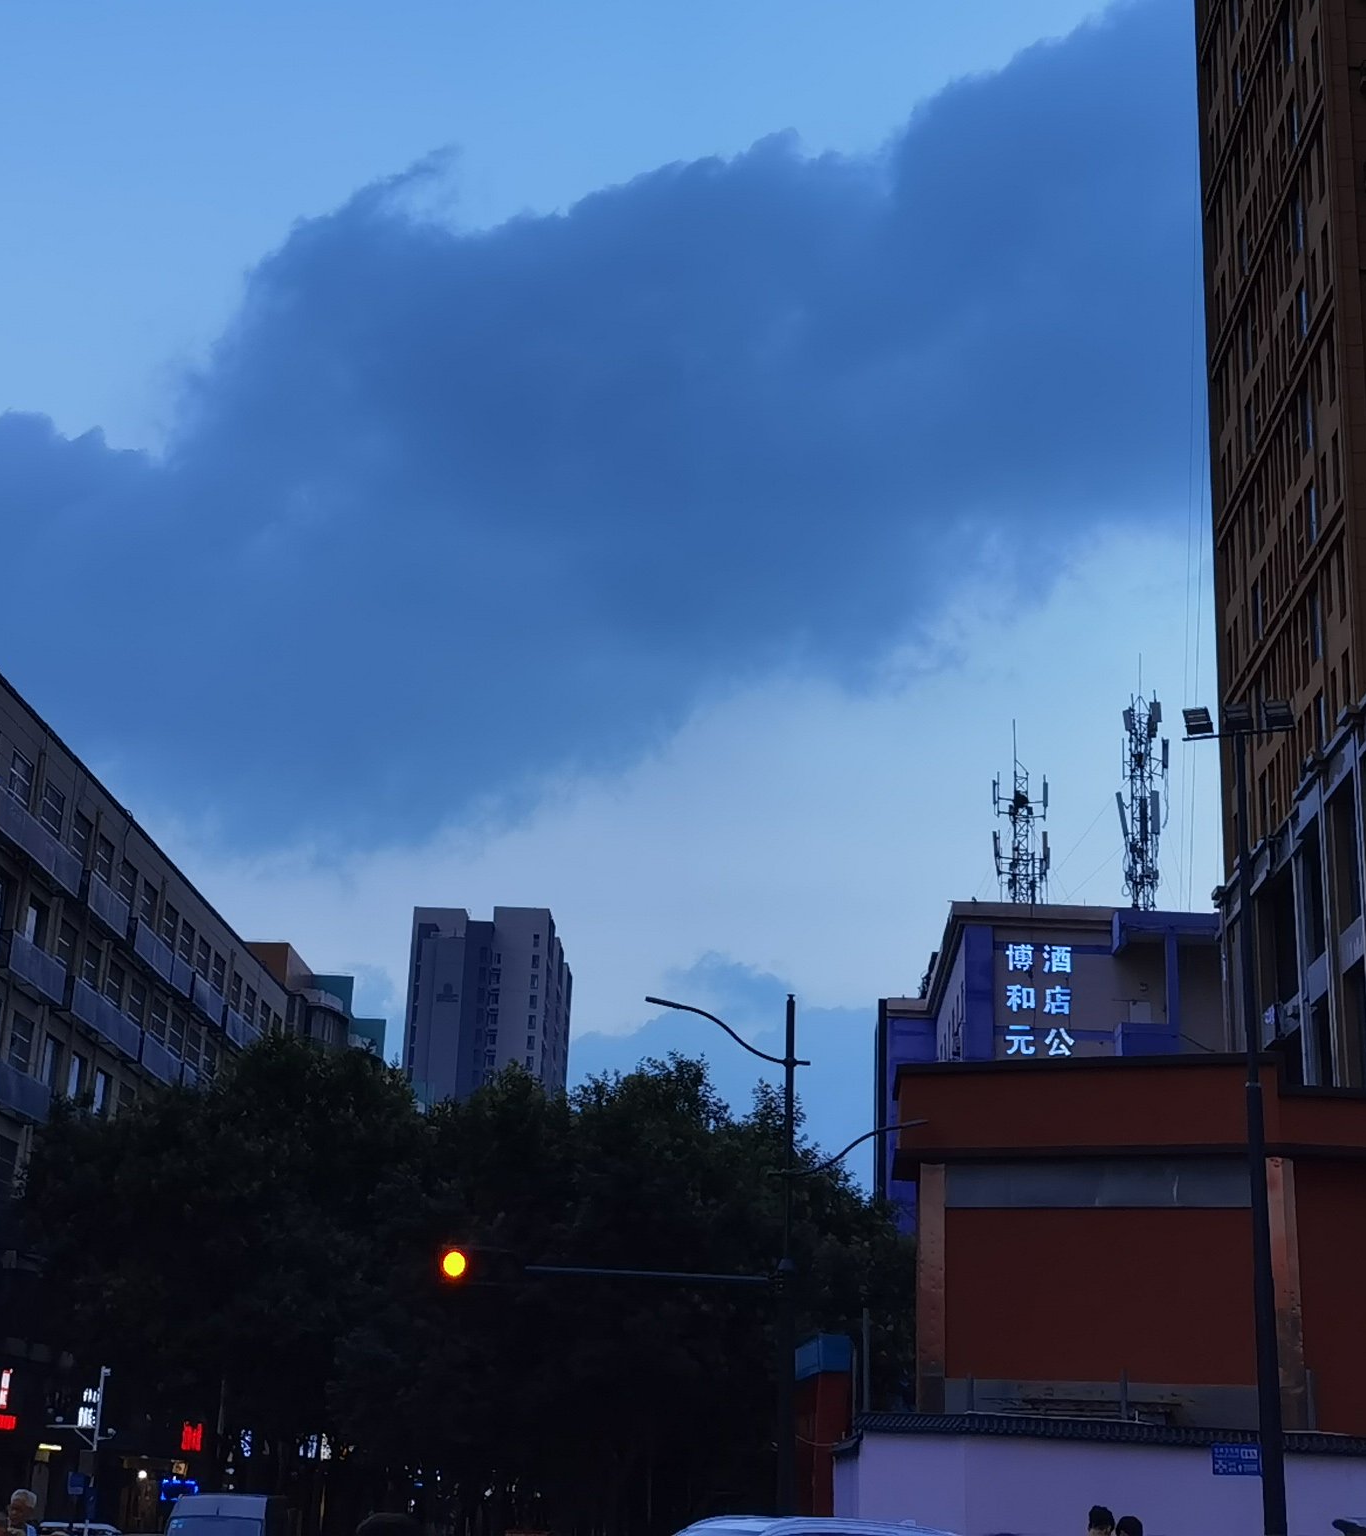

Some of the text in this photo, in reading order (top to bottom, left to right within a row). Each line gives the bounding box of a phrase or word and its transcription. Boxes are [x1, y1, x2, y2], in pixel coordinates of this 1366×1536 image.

[1006, 944, 1035, 1055] 博和元
[1043, 944, 1074, 1056] 酒店公
